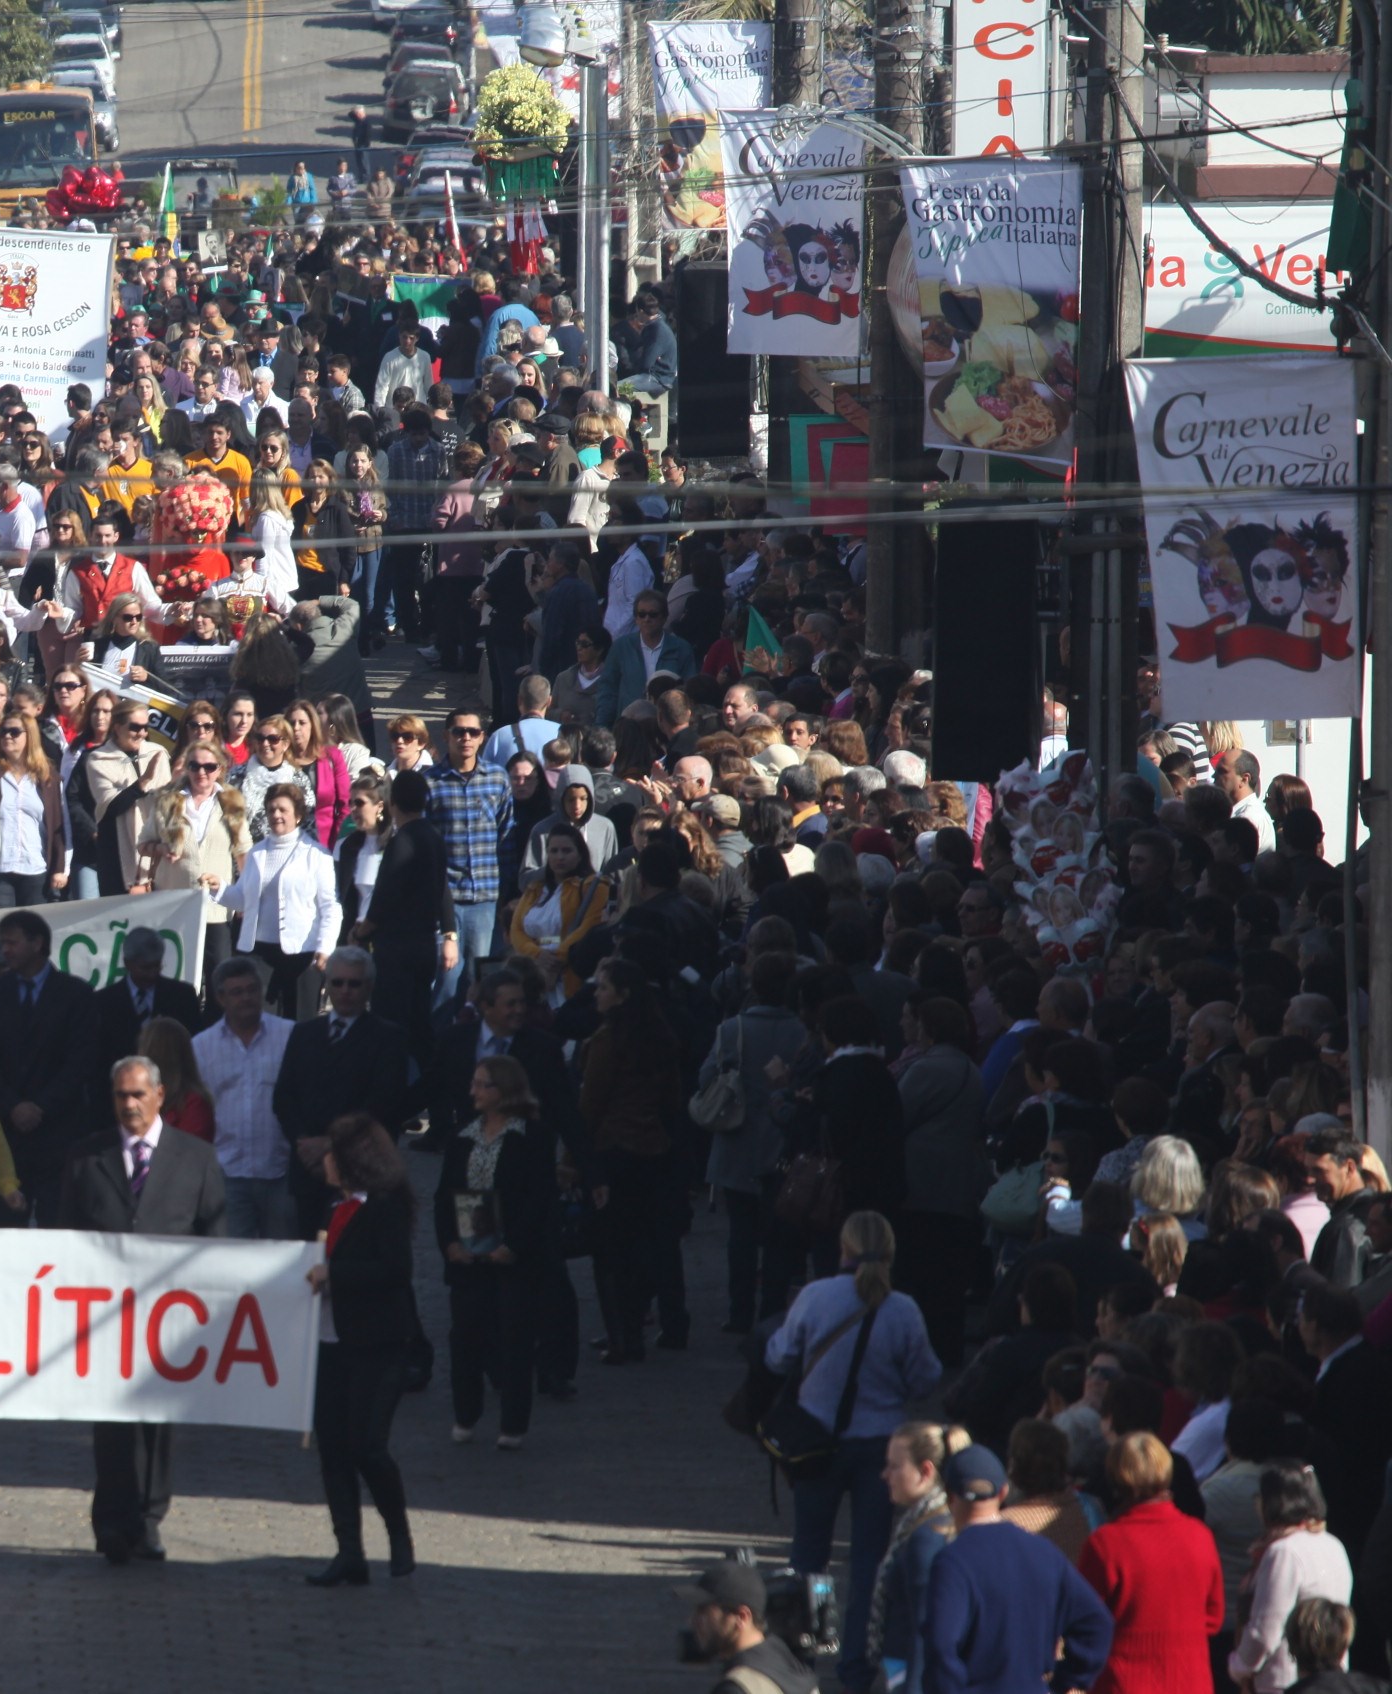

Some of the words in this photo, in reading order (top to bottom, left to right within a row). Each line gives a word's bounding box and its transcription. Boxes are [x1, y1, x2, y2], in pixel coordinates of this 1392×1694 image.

[668, 41, 702, 53] Festa
[707, 41, 723, 52] da
[654, 45, 769, 69] Gastronomia
[972, 0, 1035, 159] CIA
[3, 110, 56, 122] ESCOLAR
[739, 134, 856, 177] Carnevale
[928, 183, 980, 200] Festa
[987, 183, 1011, 201] da
[911, 198, 1077, 226] Gastronomia
[1005, 222, 1077, 247] Italiana
[77, 241, 92, 253] de
[13, 327, 18, 337] E
[21, 324, 51, 337] ROSA
[53, 301, 92, 332] CESCON
[13, 346, 47, 357] Antonia
[49, 348, 95, 360] Carminatti
[13, 360, 40, 371] Nicolò
[23, 374, 69, 385] Carminatti
[1153, 391, 1331, 459] Carnevale
[1211, 444, 1229, 460] di
[1193, 444, 1350, 499] Venezia
[163, 655, 206, 664] FAMIGLIA
